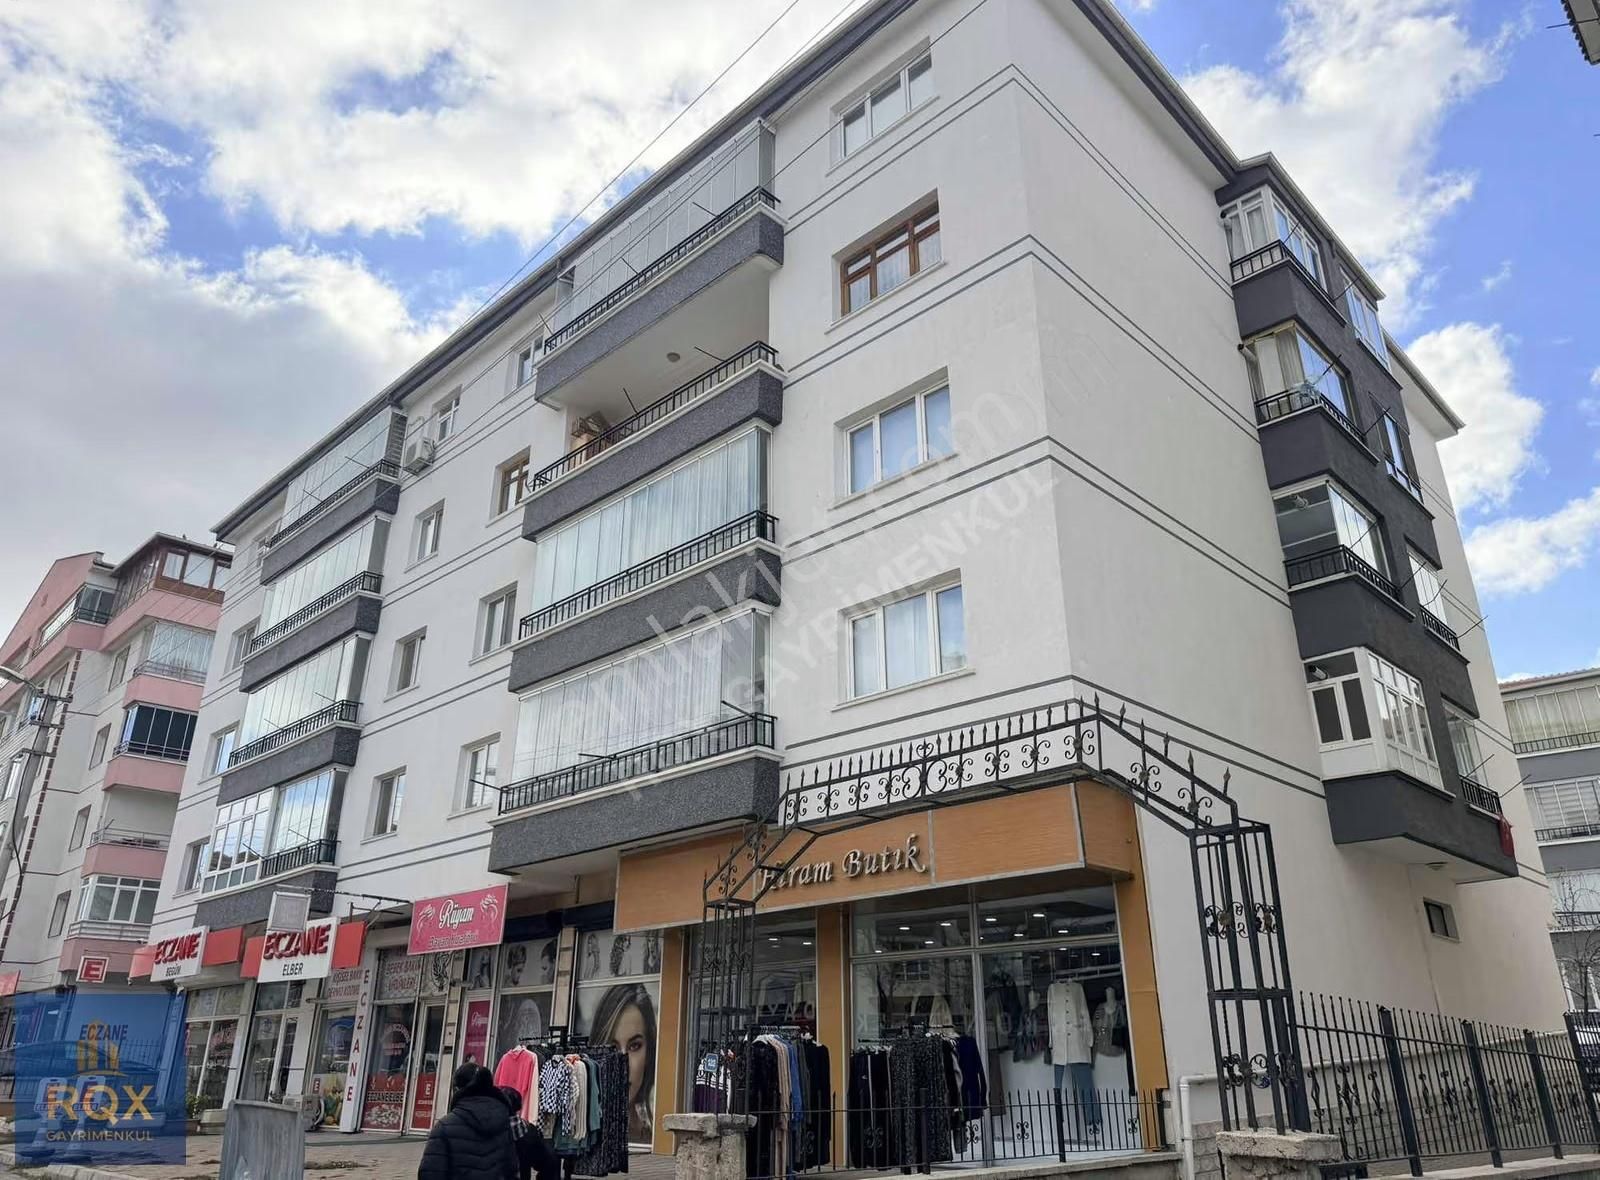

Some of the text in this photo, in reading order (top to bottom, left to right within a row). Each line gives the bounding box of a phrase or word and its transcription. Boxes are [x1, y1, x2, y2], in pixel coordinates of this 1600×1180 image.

[154, 932, 202, 965] ECZANE
[264, 924, 331, 960] ECZANE
[84, 962, 102, 980] E
[282, 962, 304, 976] ELBER
[79, 1024, 128, 1041] ECZANE
[346, 969, 370, 1102] ECZANE
